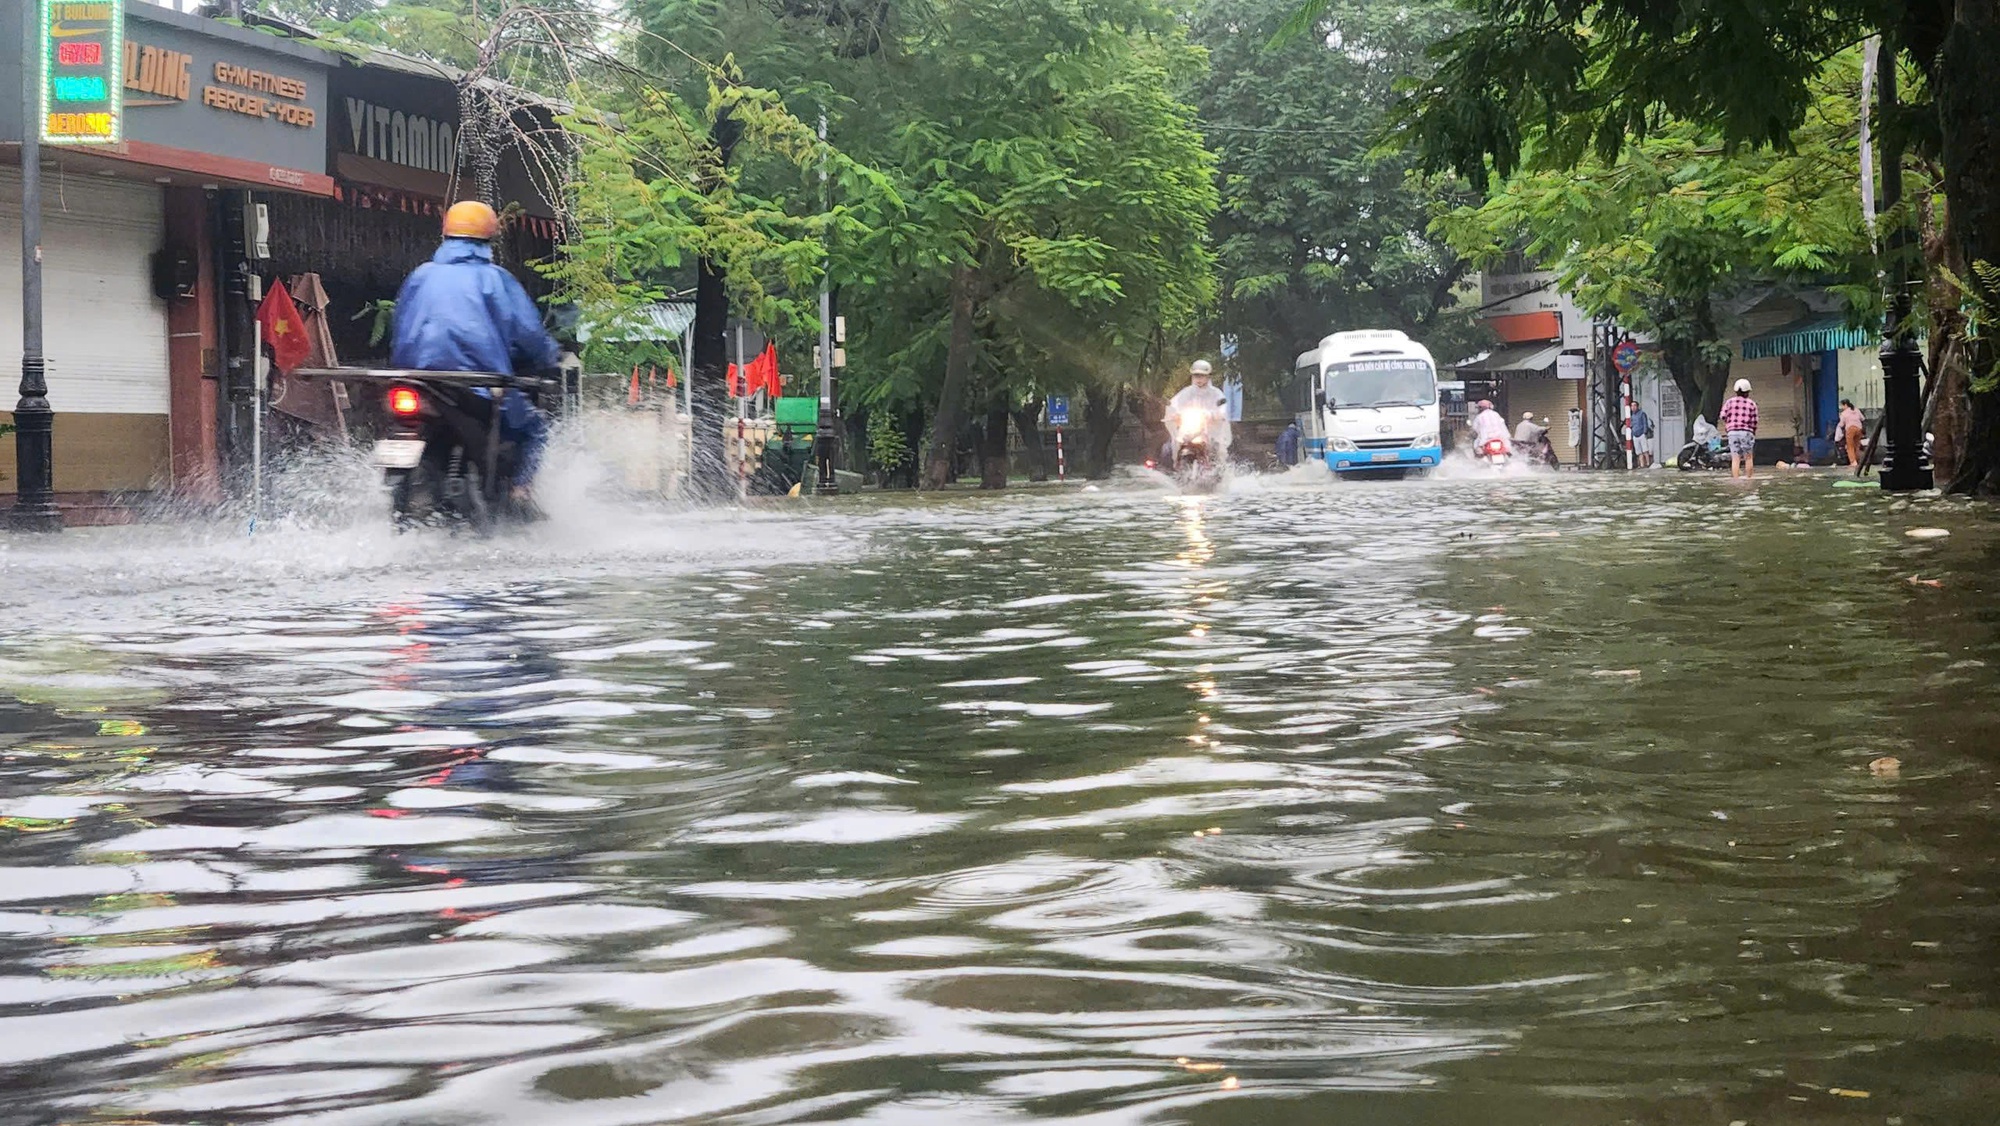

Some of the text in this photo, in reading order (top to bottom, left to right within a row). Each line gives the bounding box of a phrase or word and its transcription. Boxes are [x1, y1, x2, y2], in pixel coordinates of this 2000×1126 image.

[214, 61, 307, 101] GYM FITNESS
[48, 113, 112, 134] AEROBIC
